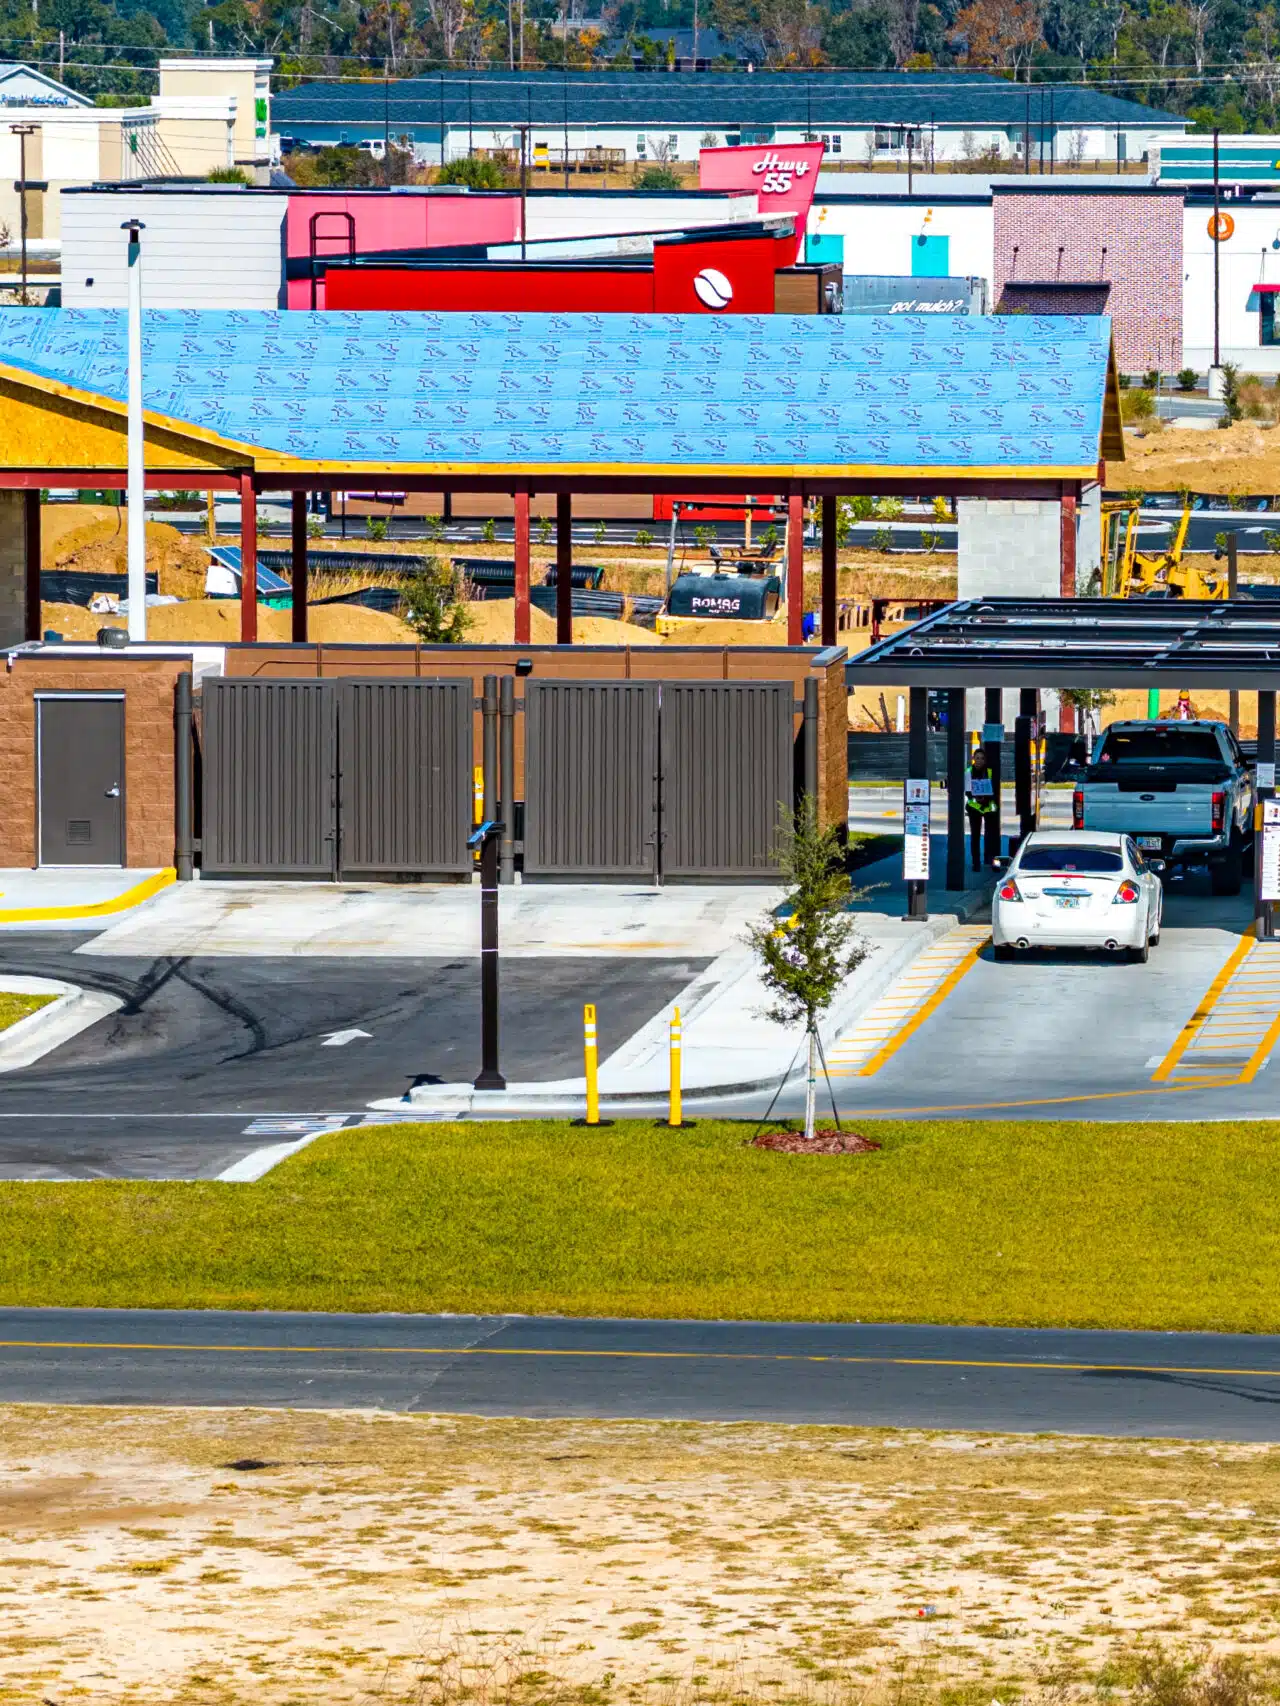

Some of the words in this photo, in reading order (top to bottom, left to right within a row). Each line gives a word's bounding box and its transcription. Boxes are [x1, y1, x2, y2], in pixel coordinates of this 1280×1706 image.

[752, 152, 810, 176] Hwy
[762, 172, 792, 192] 55
[888, 299, 917, 315] got
[914, 299, 964, 313] mulch?
